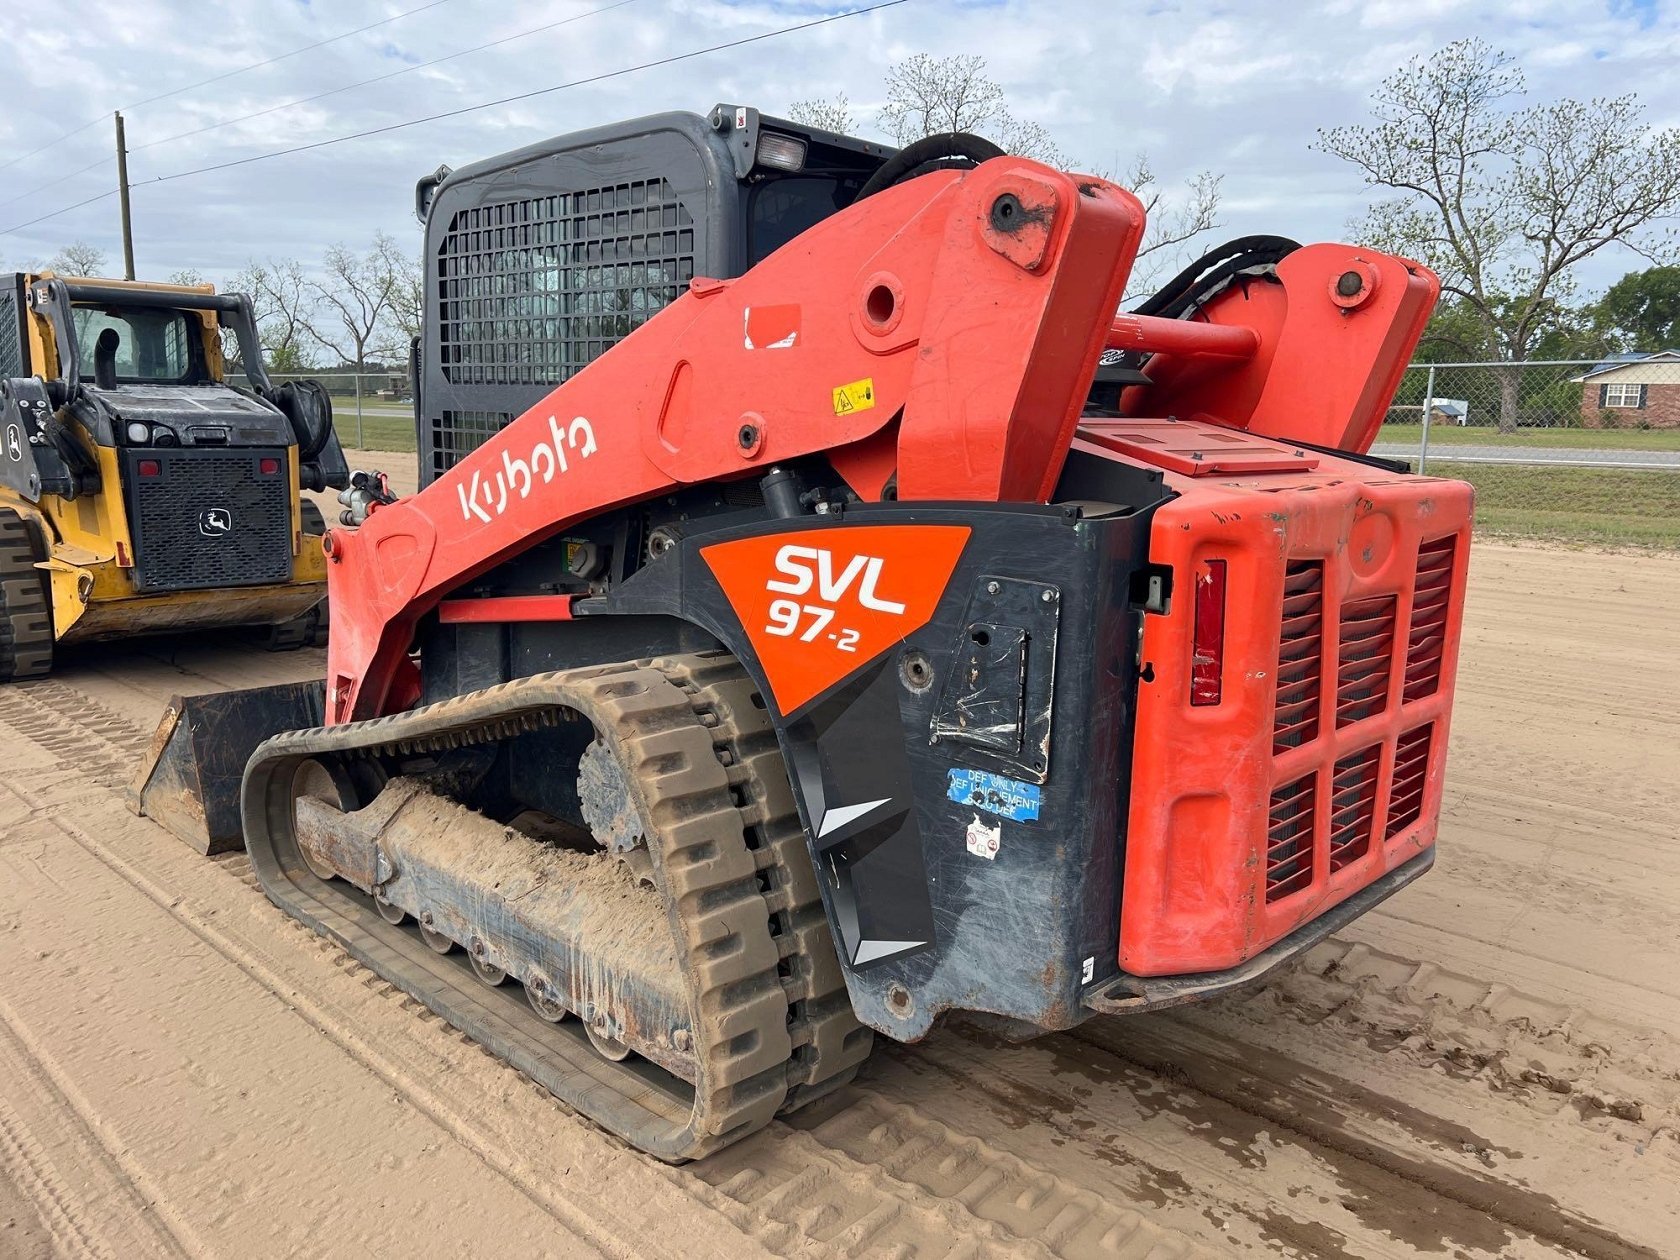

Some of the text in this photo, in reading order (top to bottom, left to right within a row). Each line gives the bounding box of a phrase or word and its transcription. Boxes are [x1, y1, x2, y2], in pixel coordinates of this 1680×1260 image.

[456, 414, 598, 524] Kubota
[765, 544, 906, 615] SVL
[764, 599, 861, 653] 97-2
[968, 769, 1018, 793] DEF ONLY
[970, 782, 1037, 810] UNIEMENT
